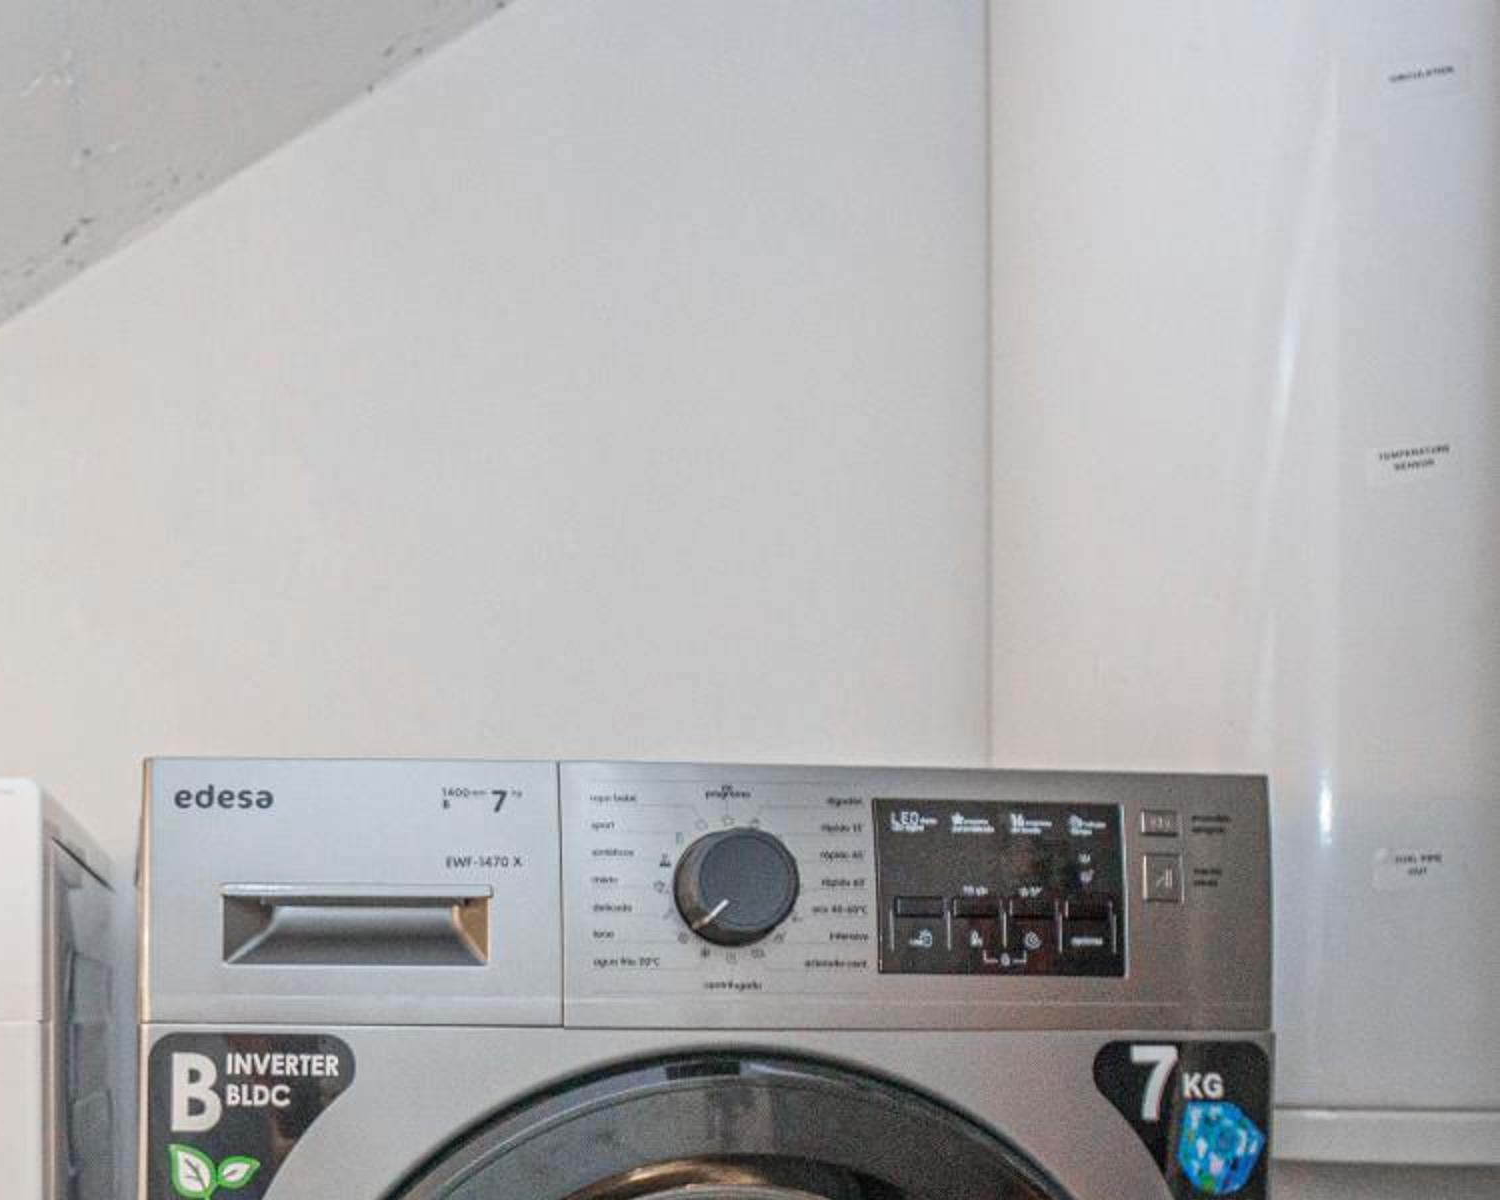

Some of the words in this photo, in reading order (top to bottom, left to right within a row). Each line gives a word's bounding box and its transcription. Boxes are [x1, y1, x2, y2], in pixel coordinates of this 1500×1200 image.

[491, 789, 507, 813] 7
[445, 855, 509, 868] EWF-1470
[513, 855, 523, 867] X
[226, 1052, 339, 1076] INVERTER
[170, 1051, 223, 1133] B
[1130, 1044, 1179, 1121] 7
[1183, 1073, 1225, 1099] KG
[226, 1084, 291, 1107] BLDC
